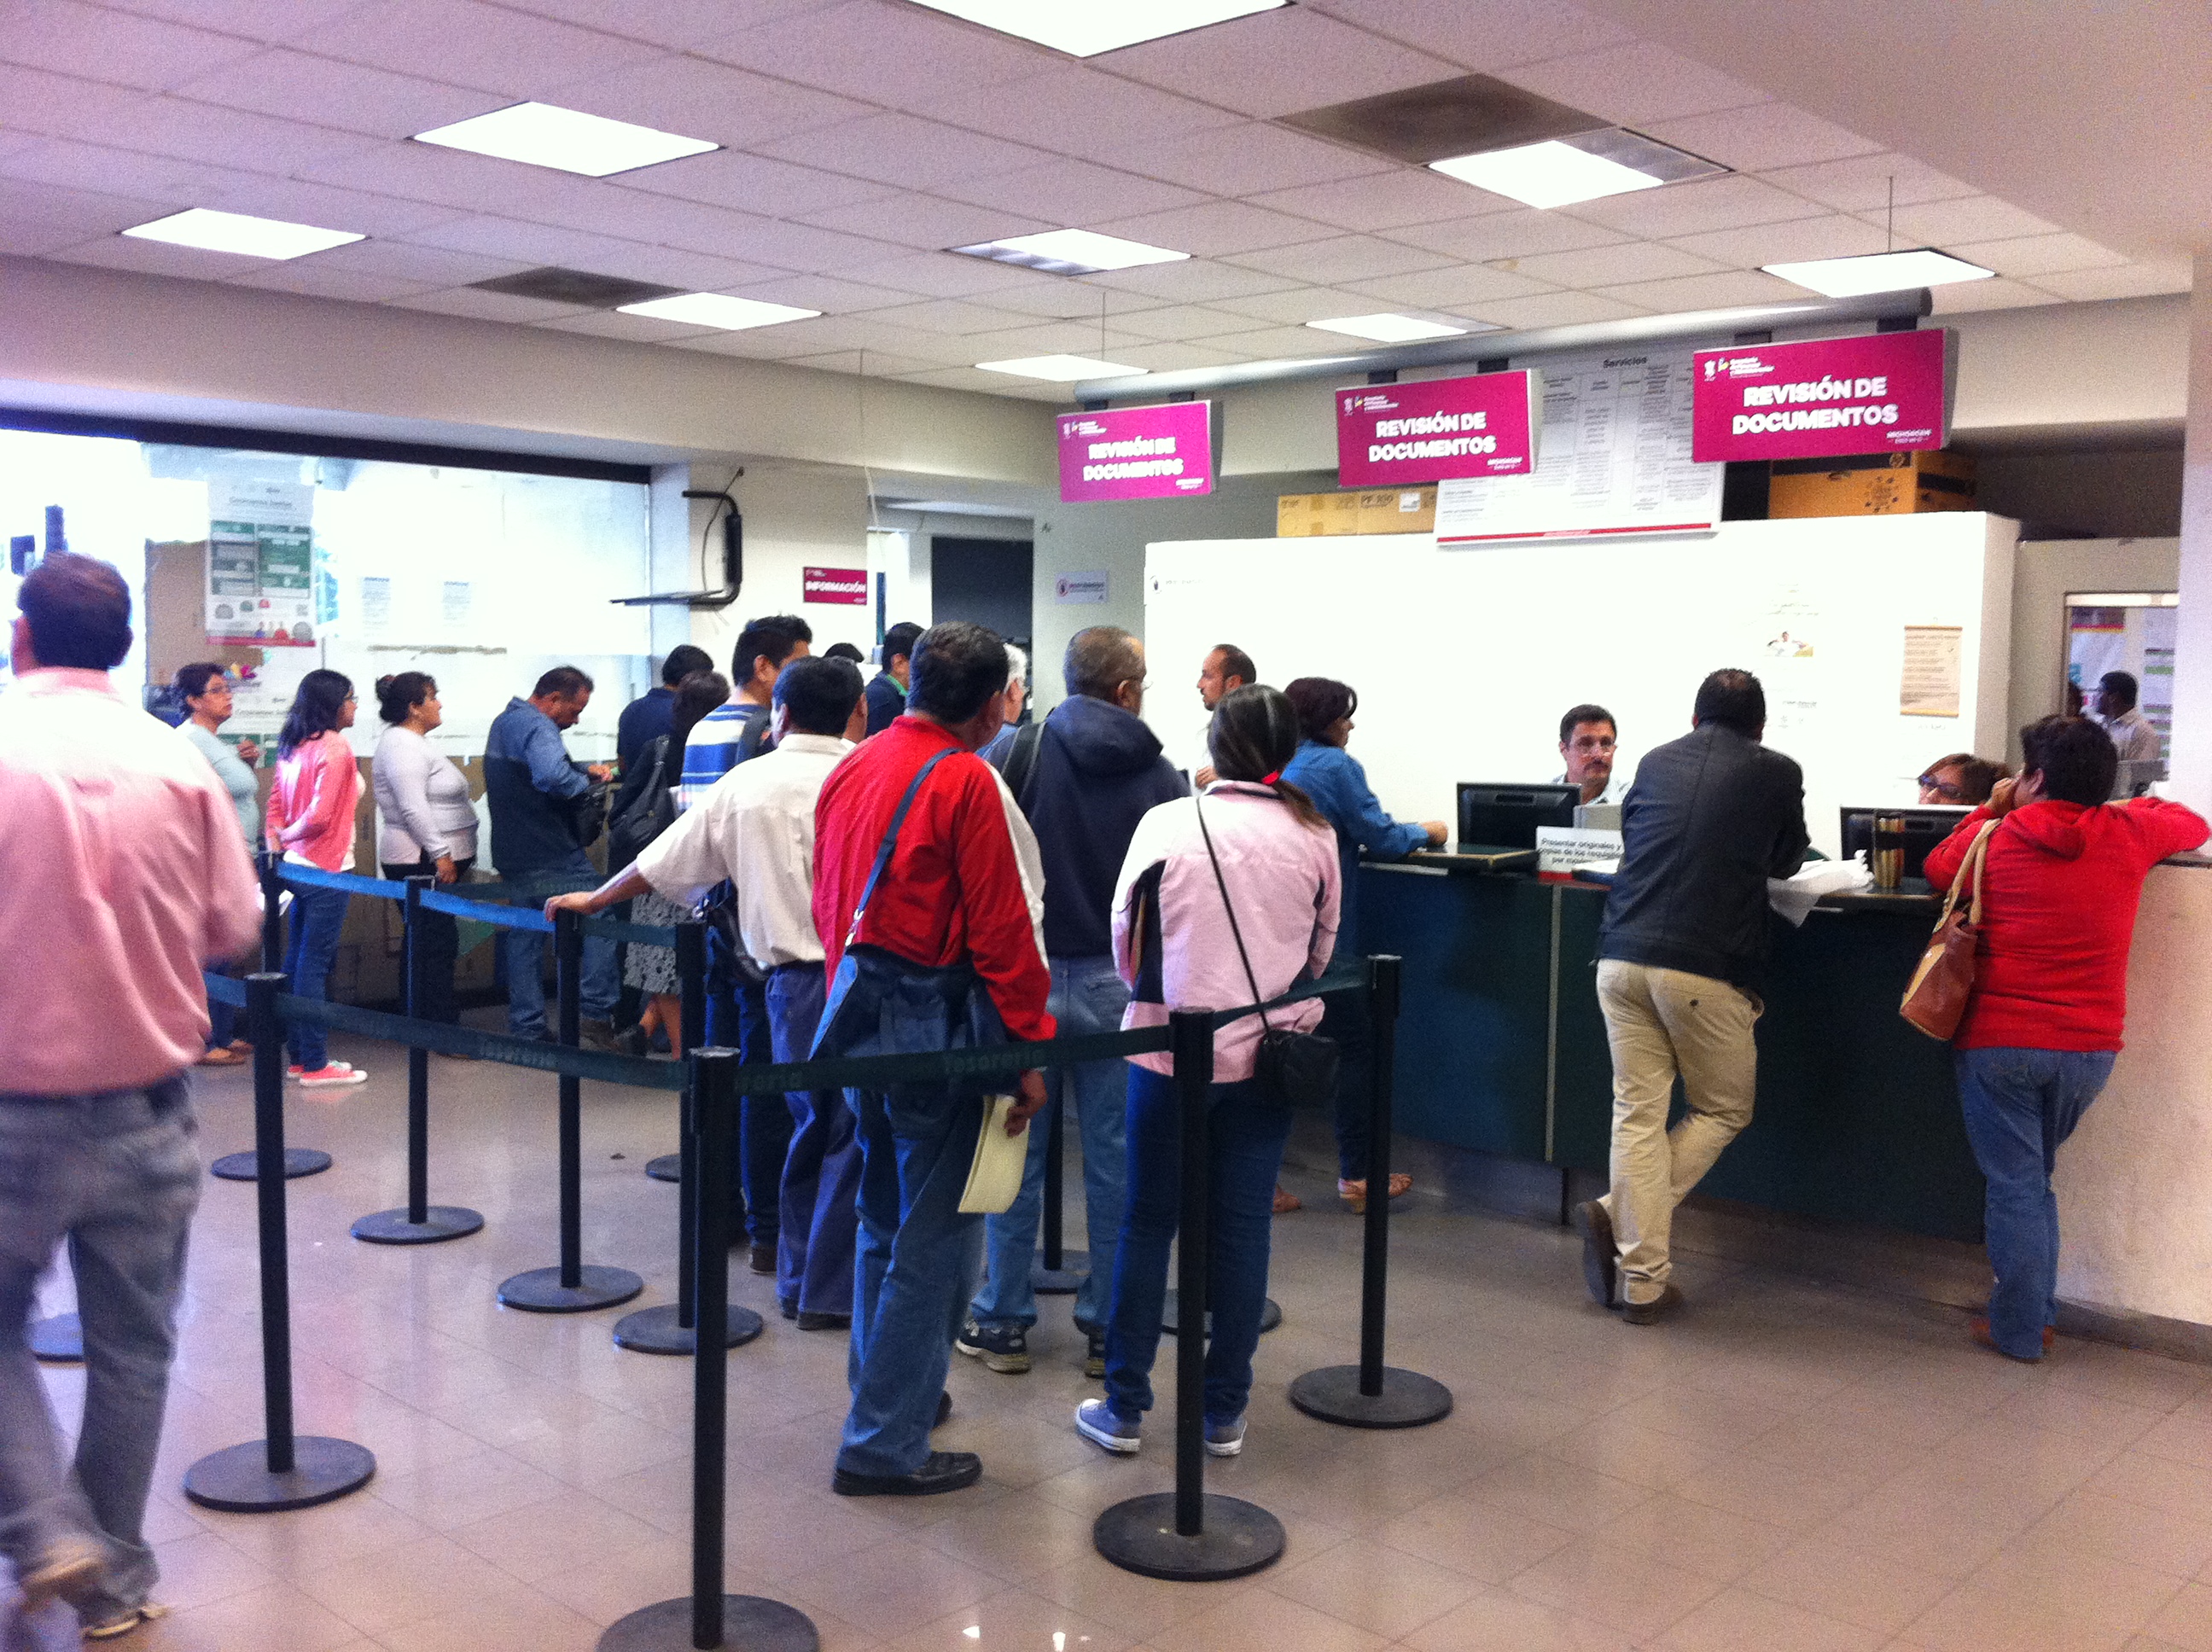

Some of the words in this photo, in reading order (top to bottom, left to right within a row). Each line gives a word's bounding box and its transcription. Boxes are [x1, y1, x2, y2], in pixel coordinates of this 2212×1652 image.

[1603, 357, 1648, 368] Servicios
[1743, 375, 1853, 407] REVISIÓN
[1854, 376, 1887, 398] DE
[1376, 410, 1459, 438] REVISIÓN
[1460, 411, 1487, 431] DE
[1732, 404, 1899, 435] DOCUMENTOS
[1088, 436, 1154, 459] REVISIÓN
[1155, 437, 1176, 454] DE
[1368, 435, 1497, 462] DOCUMENTOS
[1083, 458, 1185, 481] DOCUMENTOS
[805, 580, 866, 593] INFORMACIÓN
[1541, 838, 1577, 847] Presentar
